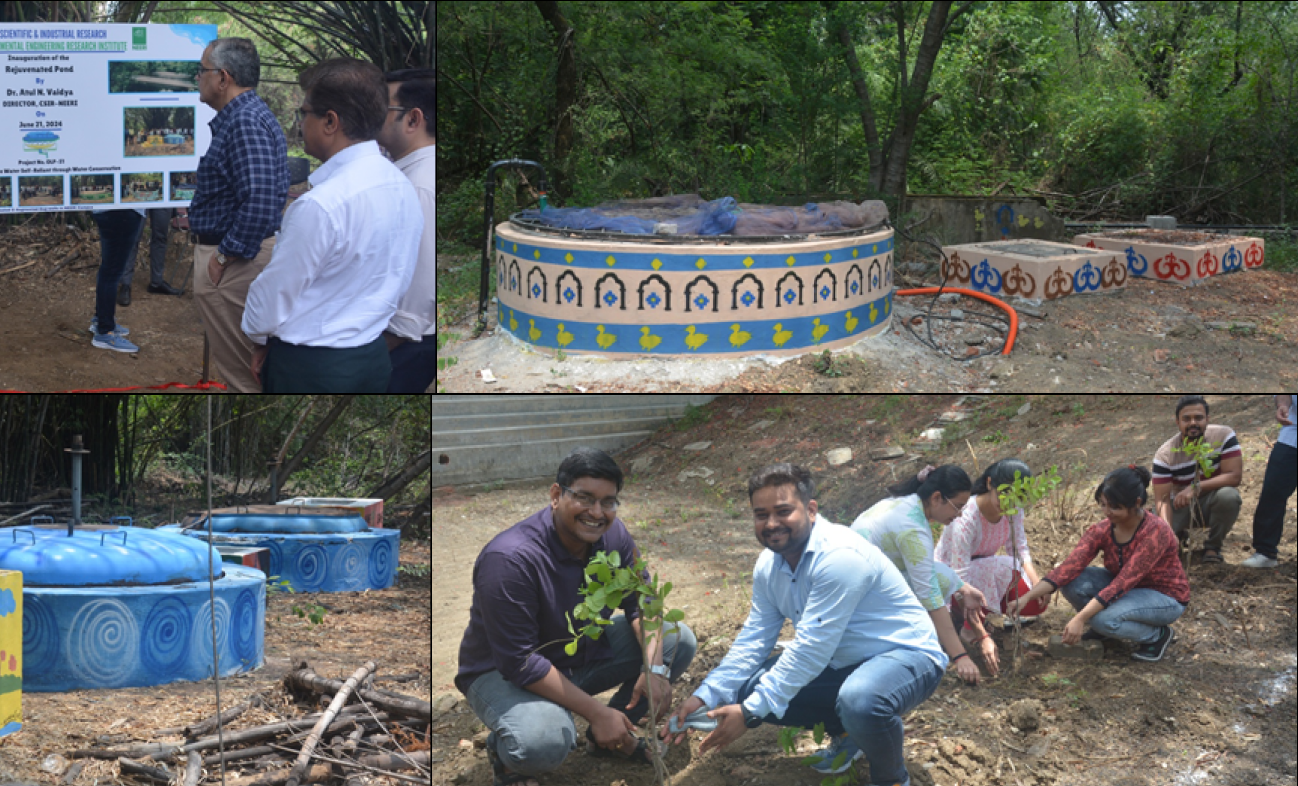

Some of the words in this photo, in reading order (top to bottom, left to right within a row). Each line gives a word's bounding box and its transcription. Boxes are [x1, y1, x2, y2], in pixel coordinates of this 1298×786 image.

[0, 29, 32, 39] SCIENTIFIC
[34, 29, 39, 39] &
[40, 29, 76, 39] INDUSTRIAL
[76, 29, 107, 39] RESEARCH
[25, 41, 65, 51] ENGINEERING
[66, 41, 97, 51] RESEARCH
[98, 41, 127, 51] INSTITUTE
[5, 66, 53, 75] Rejuvenated
[35, 77, 45, 85] By
[6, 88, 18, 97] Dr.
[19, 88, 36, 97] Atul
[36, 88, 45, 97] N.
[46, 88, 74, 98] Vaidya
[2, 100, 38, 108] DIRECTOR,
